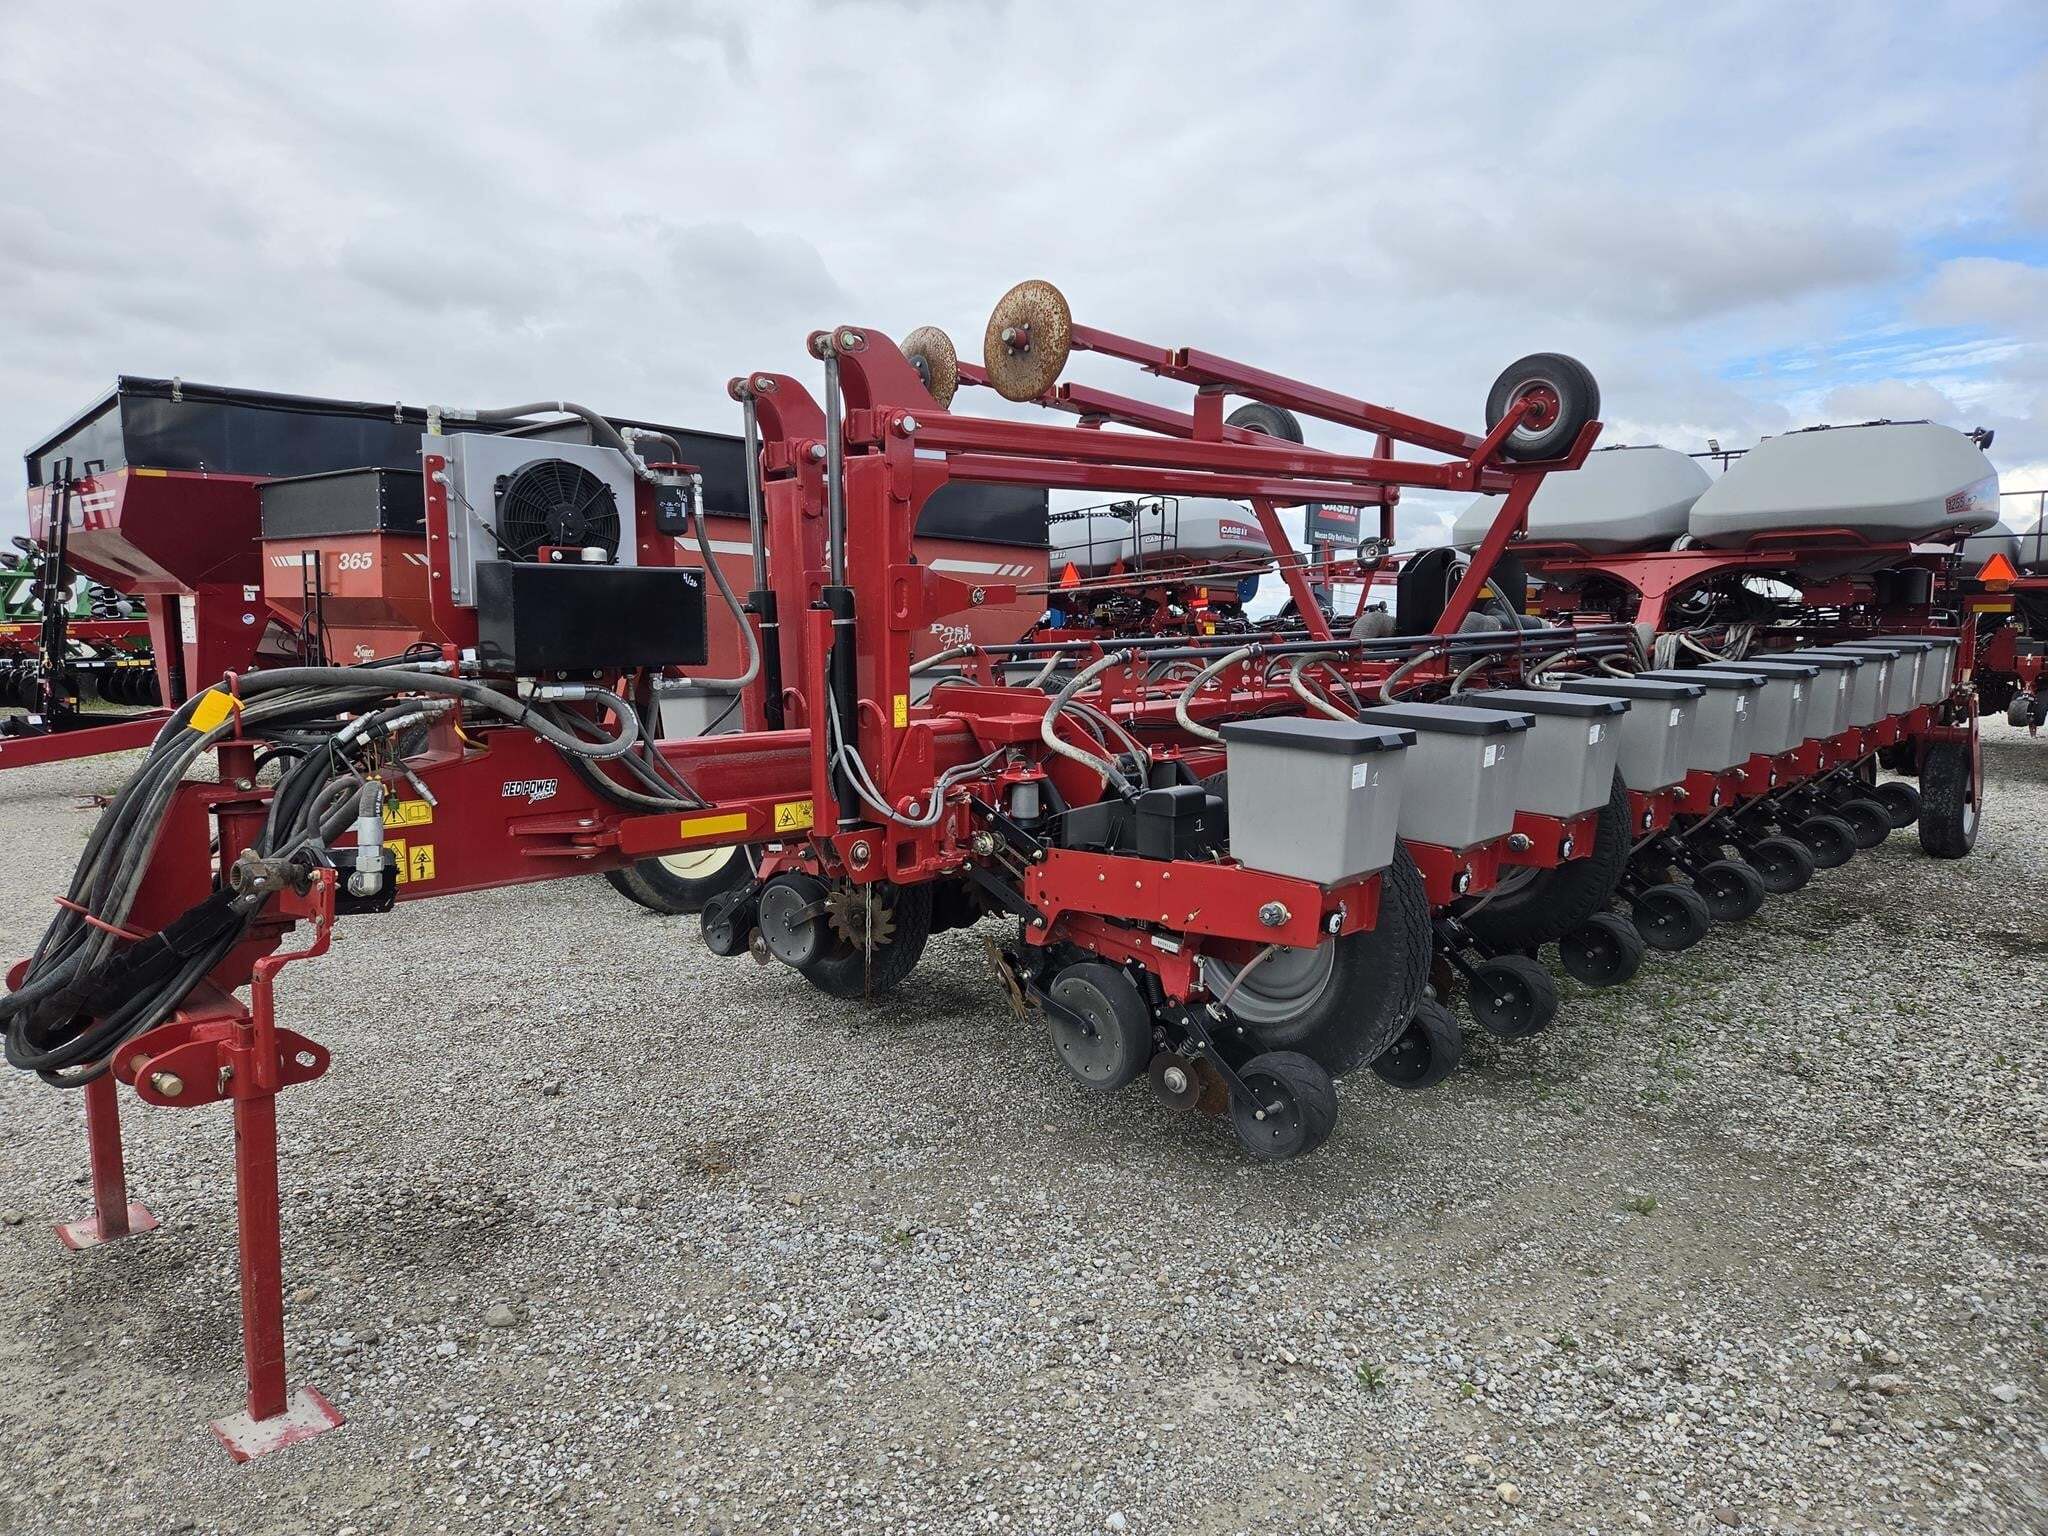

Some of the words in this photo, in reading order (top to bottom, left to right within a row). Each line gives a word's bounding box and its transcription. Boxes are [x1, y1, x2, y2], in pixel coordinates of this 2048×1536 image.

[338, 552, 373, 570] 365
[929, 623, 969, 635] Posi
[502, 781, 522, 797] RED
[522, 779, 557, 796] POWER
[1194, 818, 1204, 832] 1
